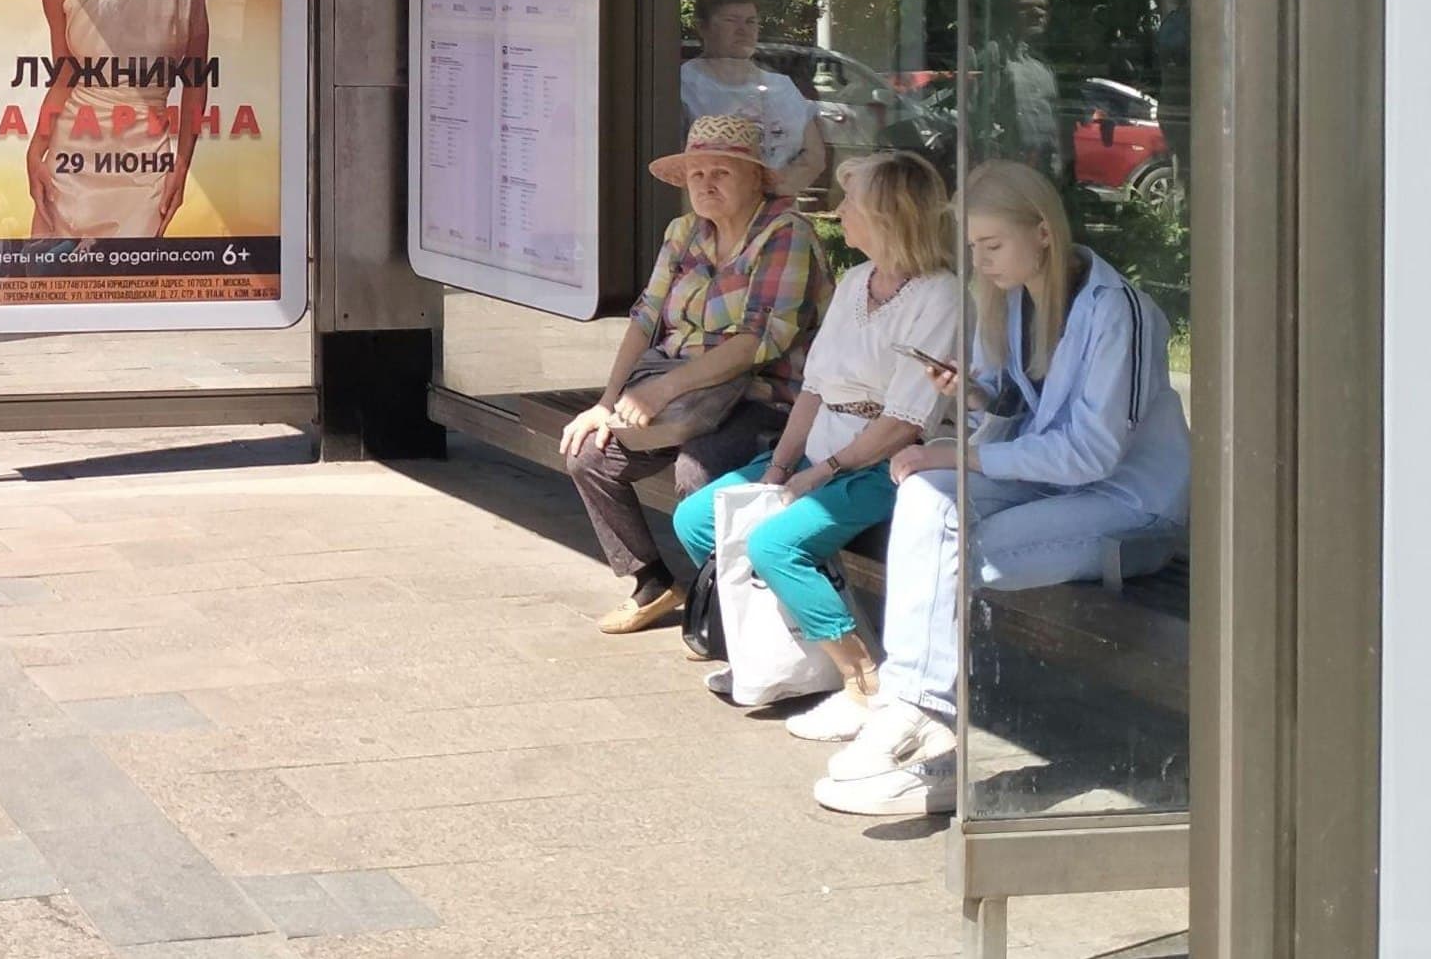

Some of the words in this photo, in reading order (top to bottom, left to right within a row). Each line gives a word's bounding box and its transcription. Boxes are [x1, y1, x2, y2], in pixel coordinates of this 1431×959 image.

[10, 56, 220, 88] ЛУЖНИКИ
[55, 152, 85, 174] 29
[94, 152, 175, 174] ИЮНЯ
[34, 253, 55, 263] на
[59, 250, 105, 263] сайте
[108, 248, 215, 266] gagarina.com
[221, 243, 251, 266] 6+
